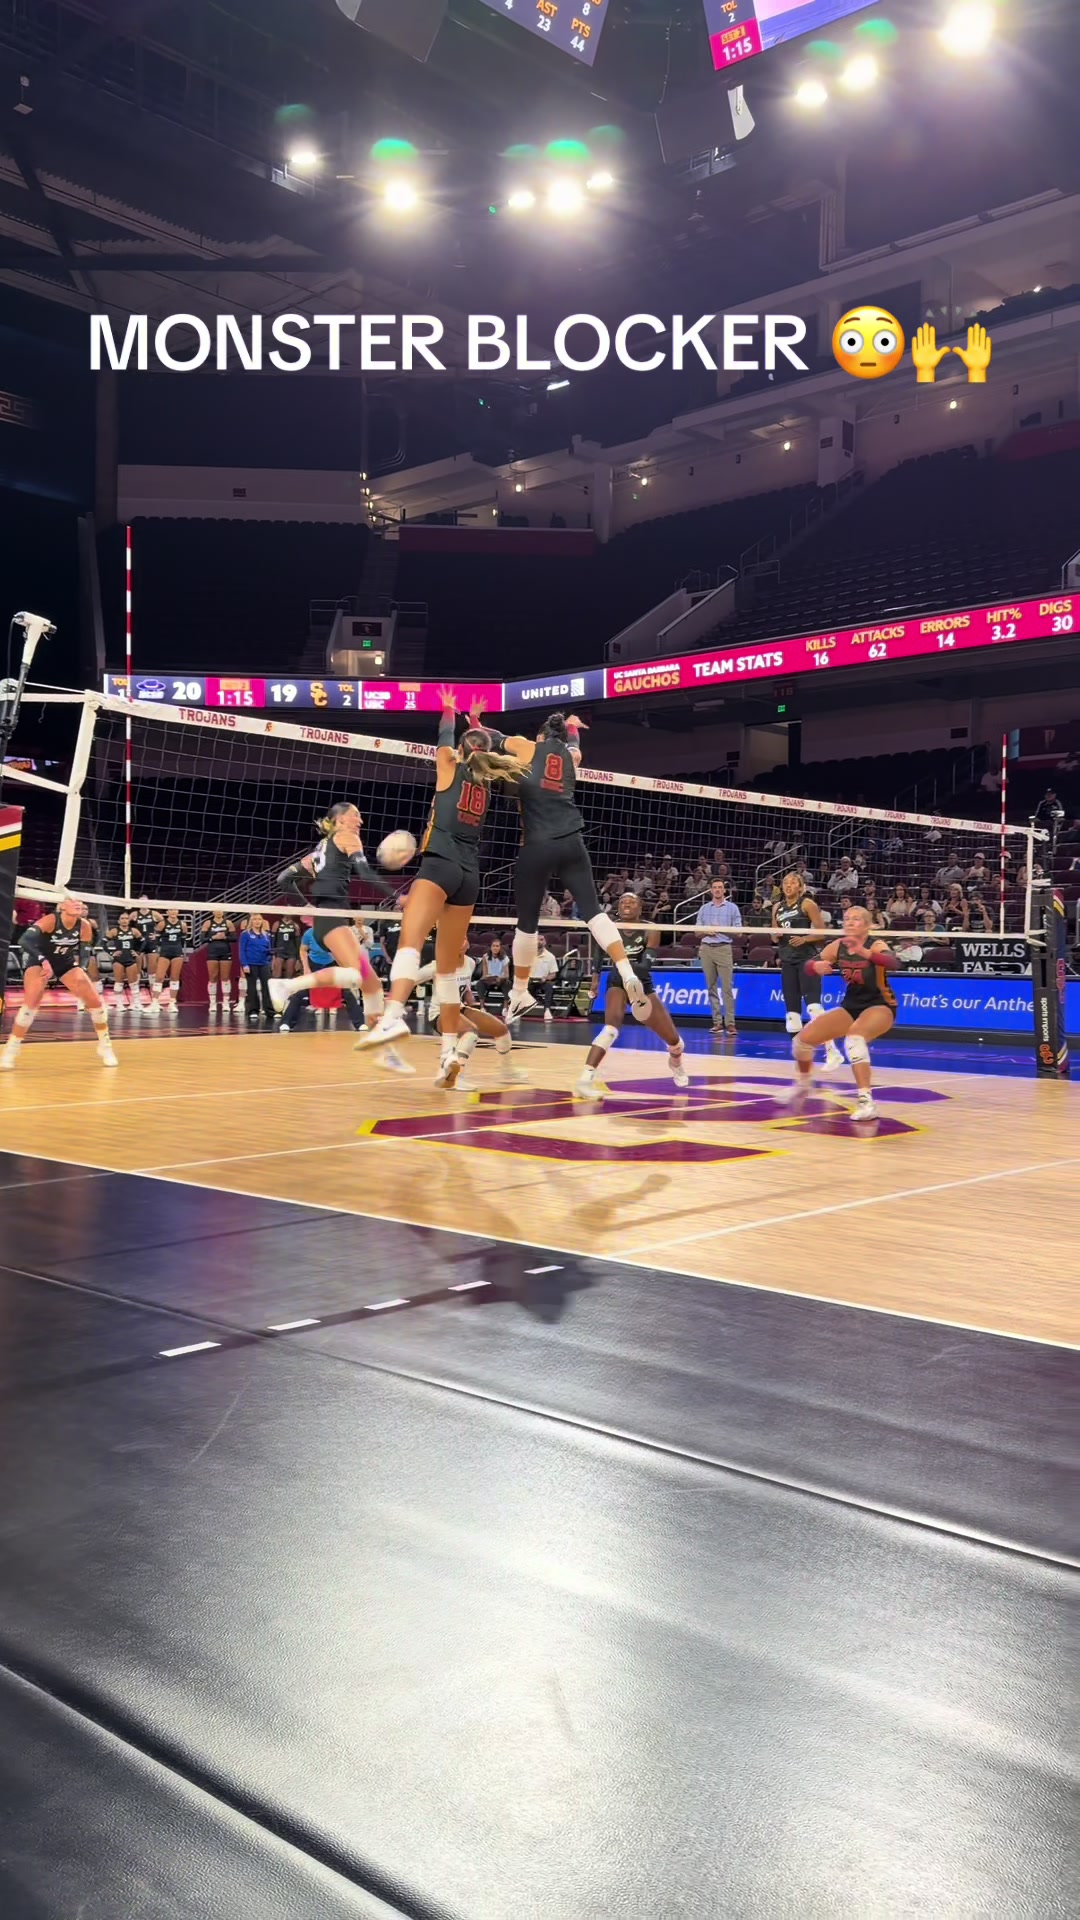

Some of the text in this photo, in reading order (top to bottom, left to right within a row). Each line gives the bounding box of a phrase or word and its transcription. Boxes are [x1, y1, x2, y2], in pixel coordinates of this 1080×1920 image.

[504, 0, 514, 9] 4
[536, 0, 558, 17] AST
[582, 2, 591, 15] 8
[720, 0, 738, 13] TOL
[537, 15, 551, 32] 23
[728, 13, 736, 23] 2
[571, 18, 591, 38] PTS
[570, 36, 585, 52] 44
[722, 31, 735, 43] SET
[722, 37, 753, 61] 1:15
[805, 600, 1072, 652] KILLS ATTACKS ERRORS HIT% DIGS
[813, 615, 1073, 666] 16 62 14 3.2 30
[693, 652, 783, 678] TEAM STATS
[614, 671, 623, 680] UC
[624, 667, 646, 678] SANTA
[172, 681, 202, 700] 20
[338, 684, 354, 692] TOL
[614, 672, 680, 693] GAUCHOS
[217, 690, 253, 705] 1:15
[271, 684, 298, 702] 19
[405, 691, 416, 700] 11
[521, 684, 569, 700] UNITED
[342, 695, 352, 706] 2
[179, 708, 236, 727] TROJANS
[299, 726, 349, 744] TROJANS
[404, 742, 438, 757] TROJA
[544, 753, 563, 780] 8
[578, 769, 614, 782] TROJANS
[652, 779, 684, 792] TROJANS
[456, 780, 486, 815] 18
[718, 788, 747, 800] TROJANS
[283, 933, 289, 941] 0
[961, 943, 1026, 958] WELLS
[652, 982, 709, 1005] them
[902, 993, 1035, 1012] That's our Anthe
